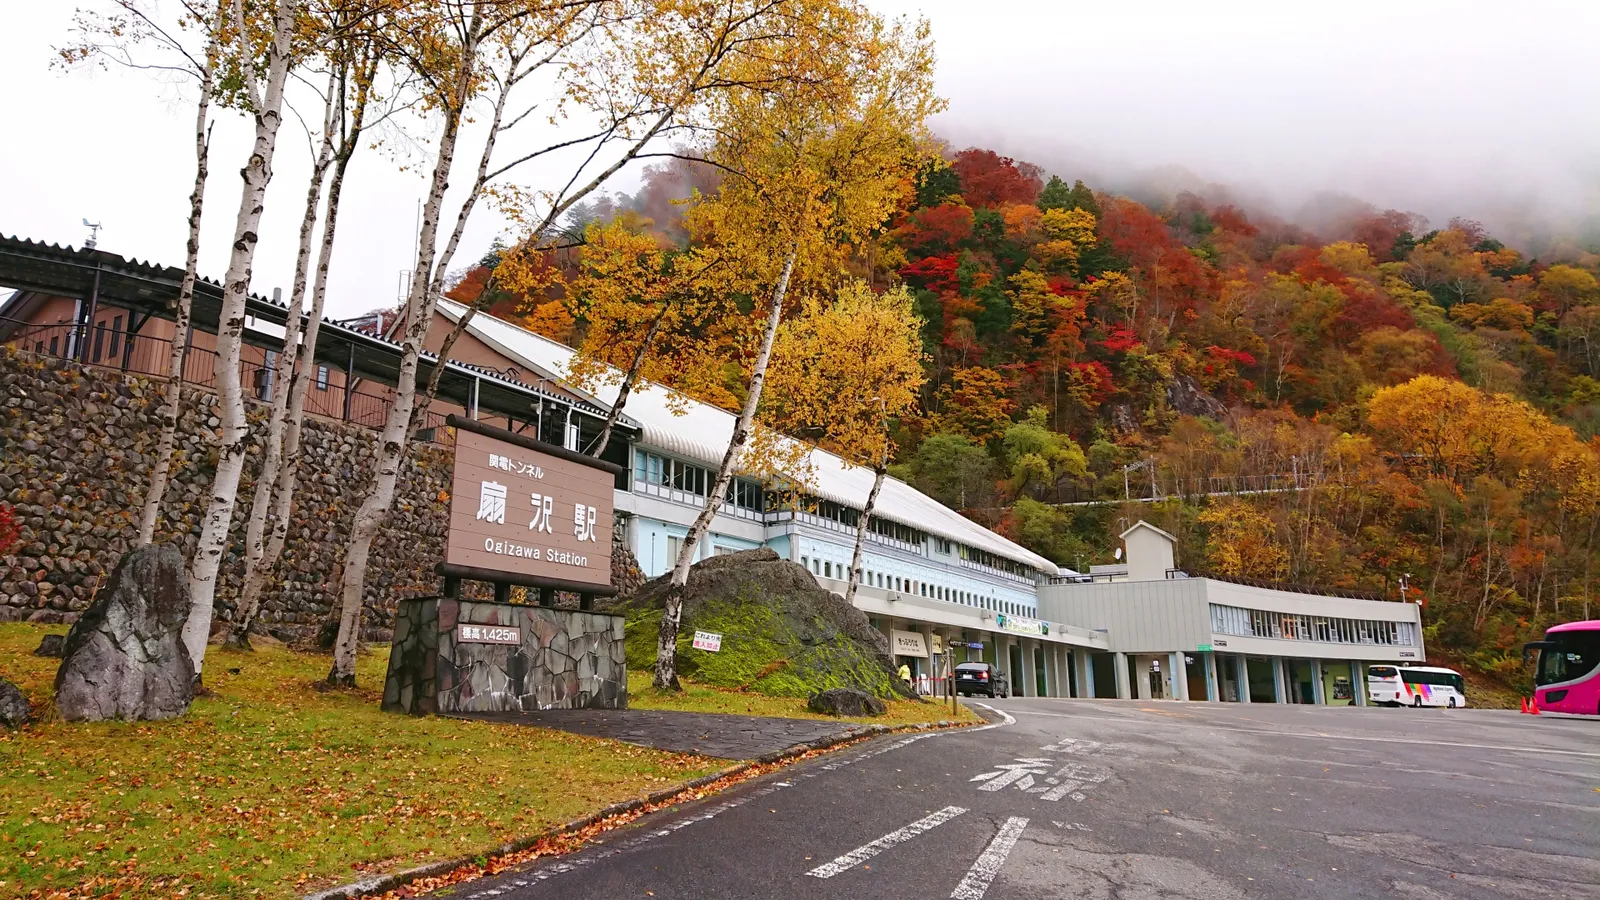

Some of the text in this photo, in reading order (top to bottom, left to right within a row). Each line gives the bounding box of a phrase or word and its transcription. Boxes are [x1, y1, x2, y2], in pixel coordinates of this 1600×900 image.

[488, 453, 544, 479] 関電トンネル
[476, 481, 597, 543] 扇沢駅
[484, 538, 588, 566] Ogizawa Station
[695, 632, 721, 642] これより先
